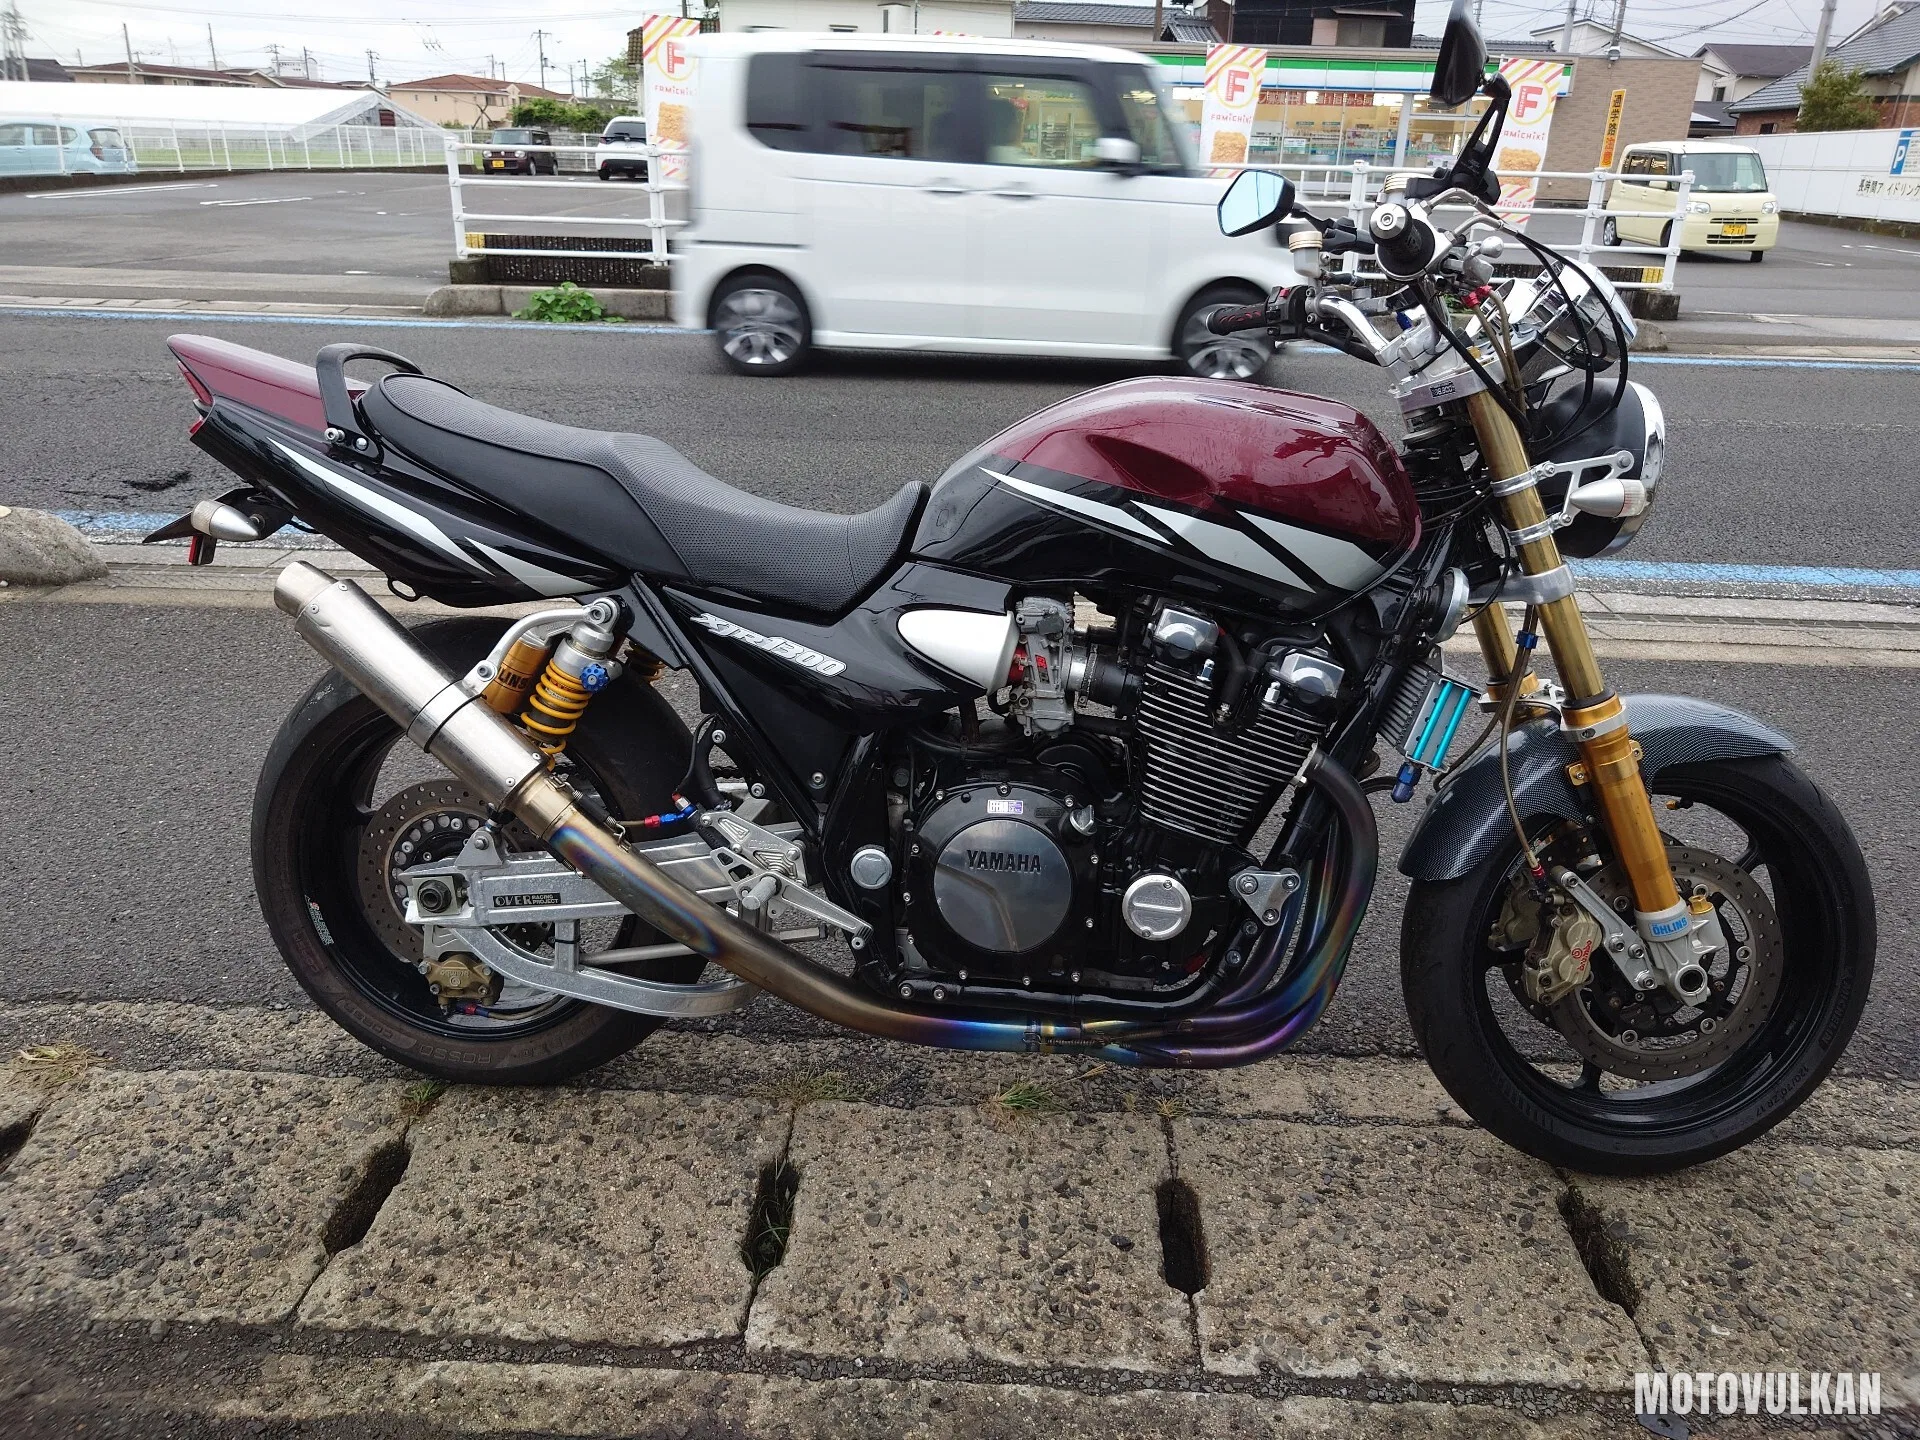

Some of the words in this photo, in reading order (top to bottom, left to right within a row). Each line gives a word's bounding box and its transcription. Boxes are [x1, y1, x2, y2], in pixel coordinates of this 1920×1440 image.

[1892, 145, 1906, 169] P
[690, 612, 847, 678] XJR1300
[966, 849, 1041, 873] YAMAHA
[495, 895, 532, 906] OVER
[1651, 916, 1688, 936] ÖHLINS
[420, 1044, 491, 1064] ROSSO
